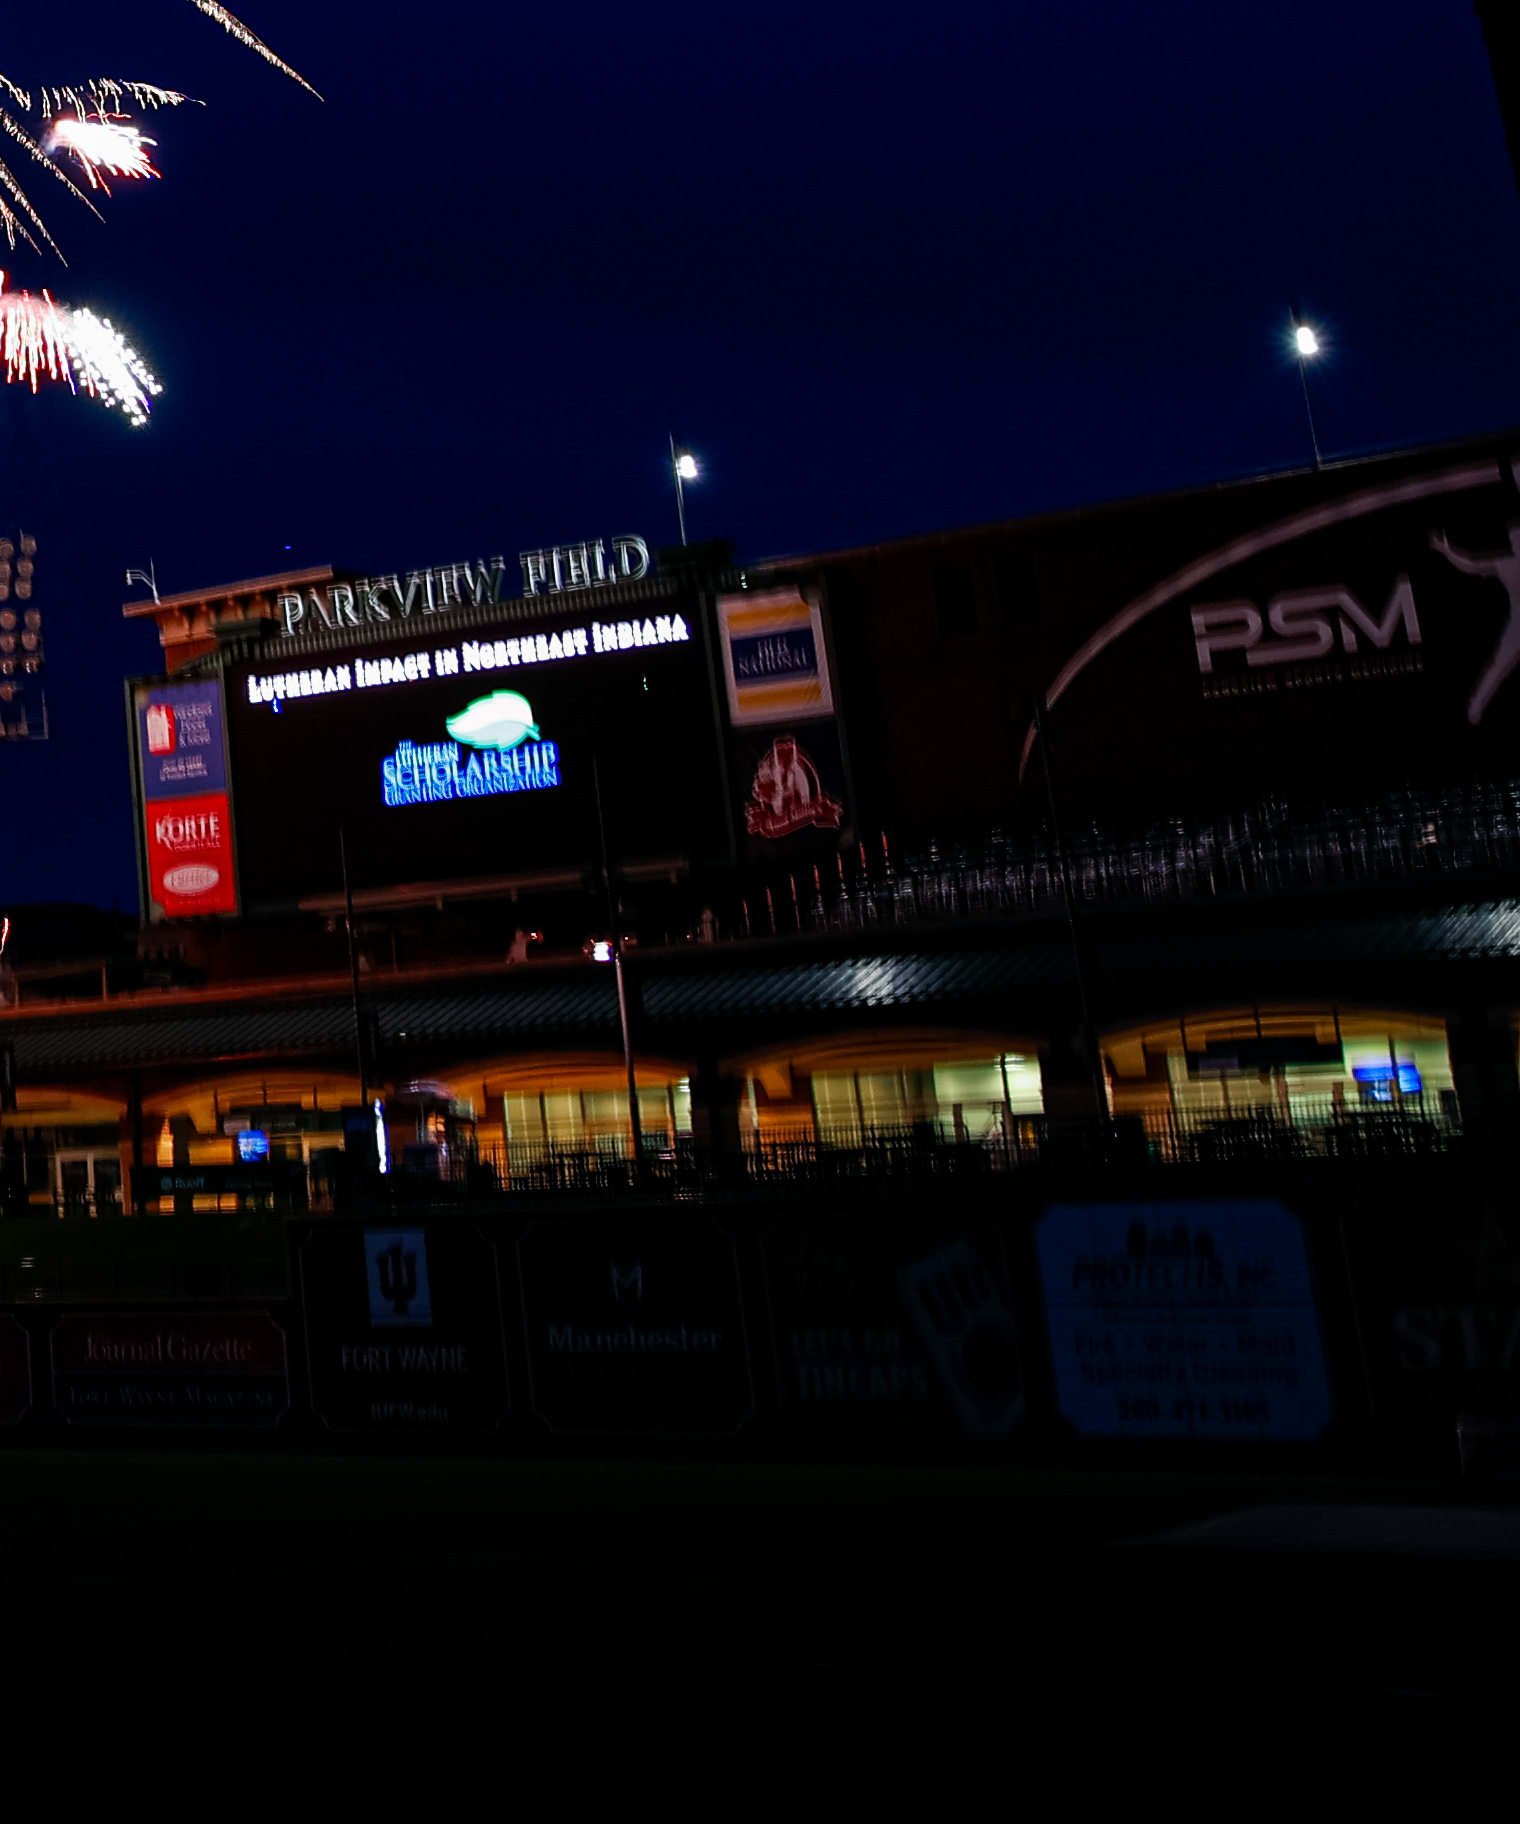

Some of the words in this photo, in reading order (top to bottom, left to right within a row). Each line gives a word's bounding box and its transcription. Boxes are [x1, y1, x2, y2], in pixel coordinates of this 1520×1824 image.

[276, 554, 506, 638] PARKVIEW
[518, 532, 651, 599] FIELD
[1189, 569, 1424, 676] PSM
[382, 741, 558, 792] SCHOLARSHIP
[155, 809, 221, 852] KORTE
[83, 1332, 162, 1364] Journal
[164, 1334, 255, 1364] Gazette
[340, 1343, 393, 1374] FORT
[396, 1343, 470, 1375] WAYNE
[546, 1321, 725, 1355] Manchester
